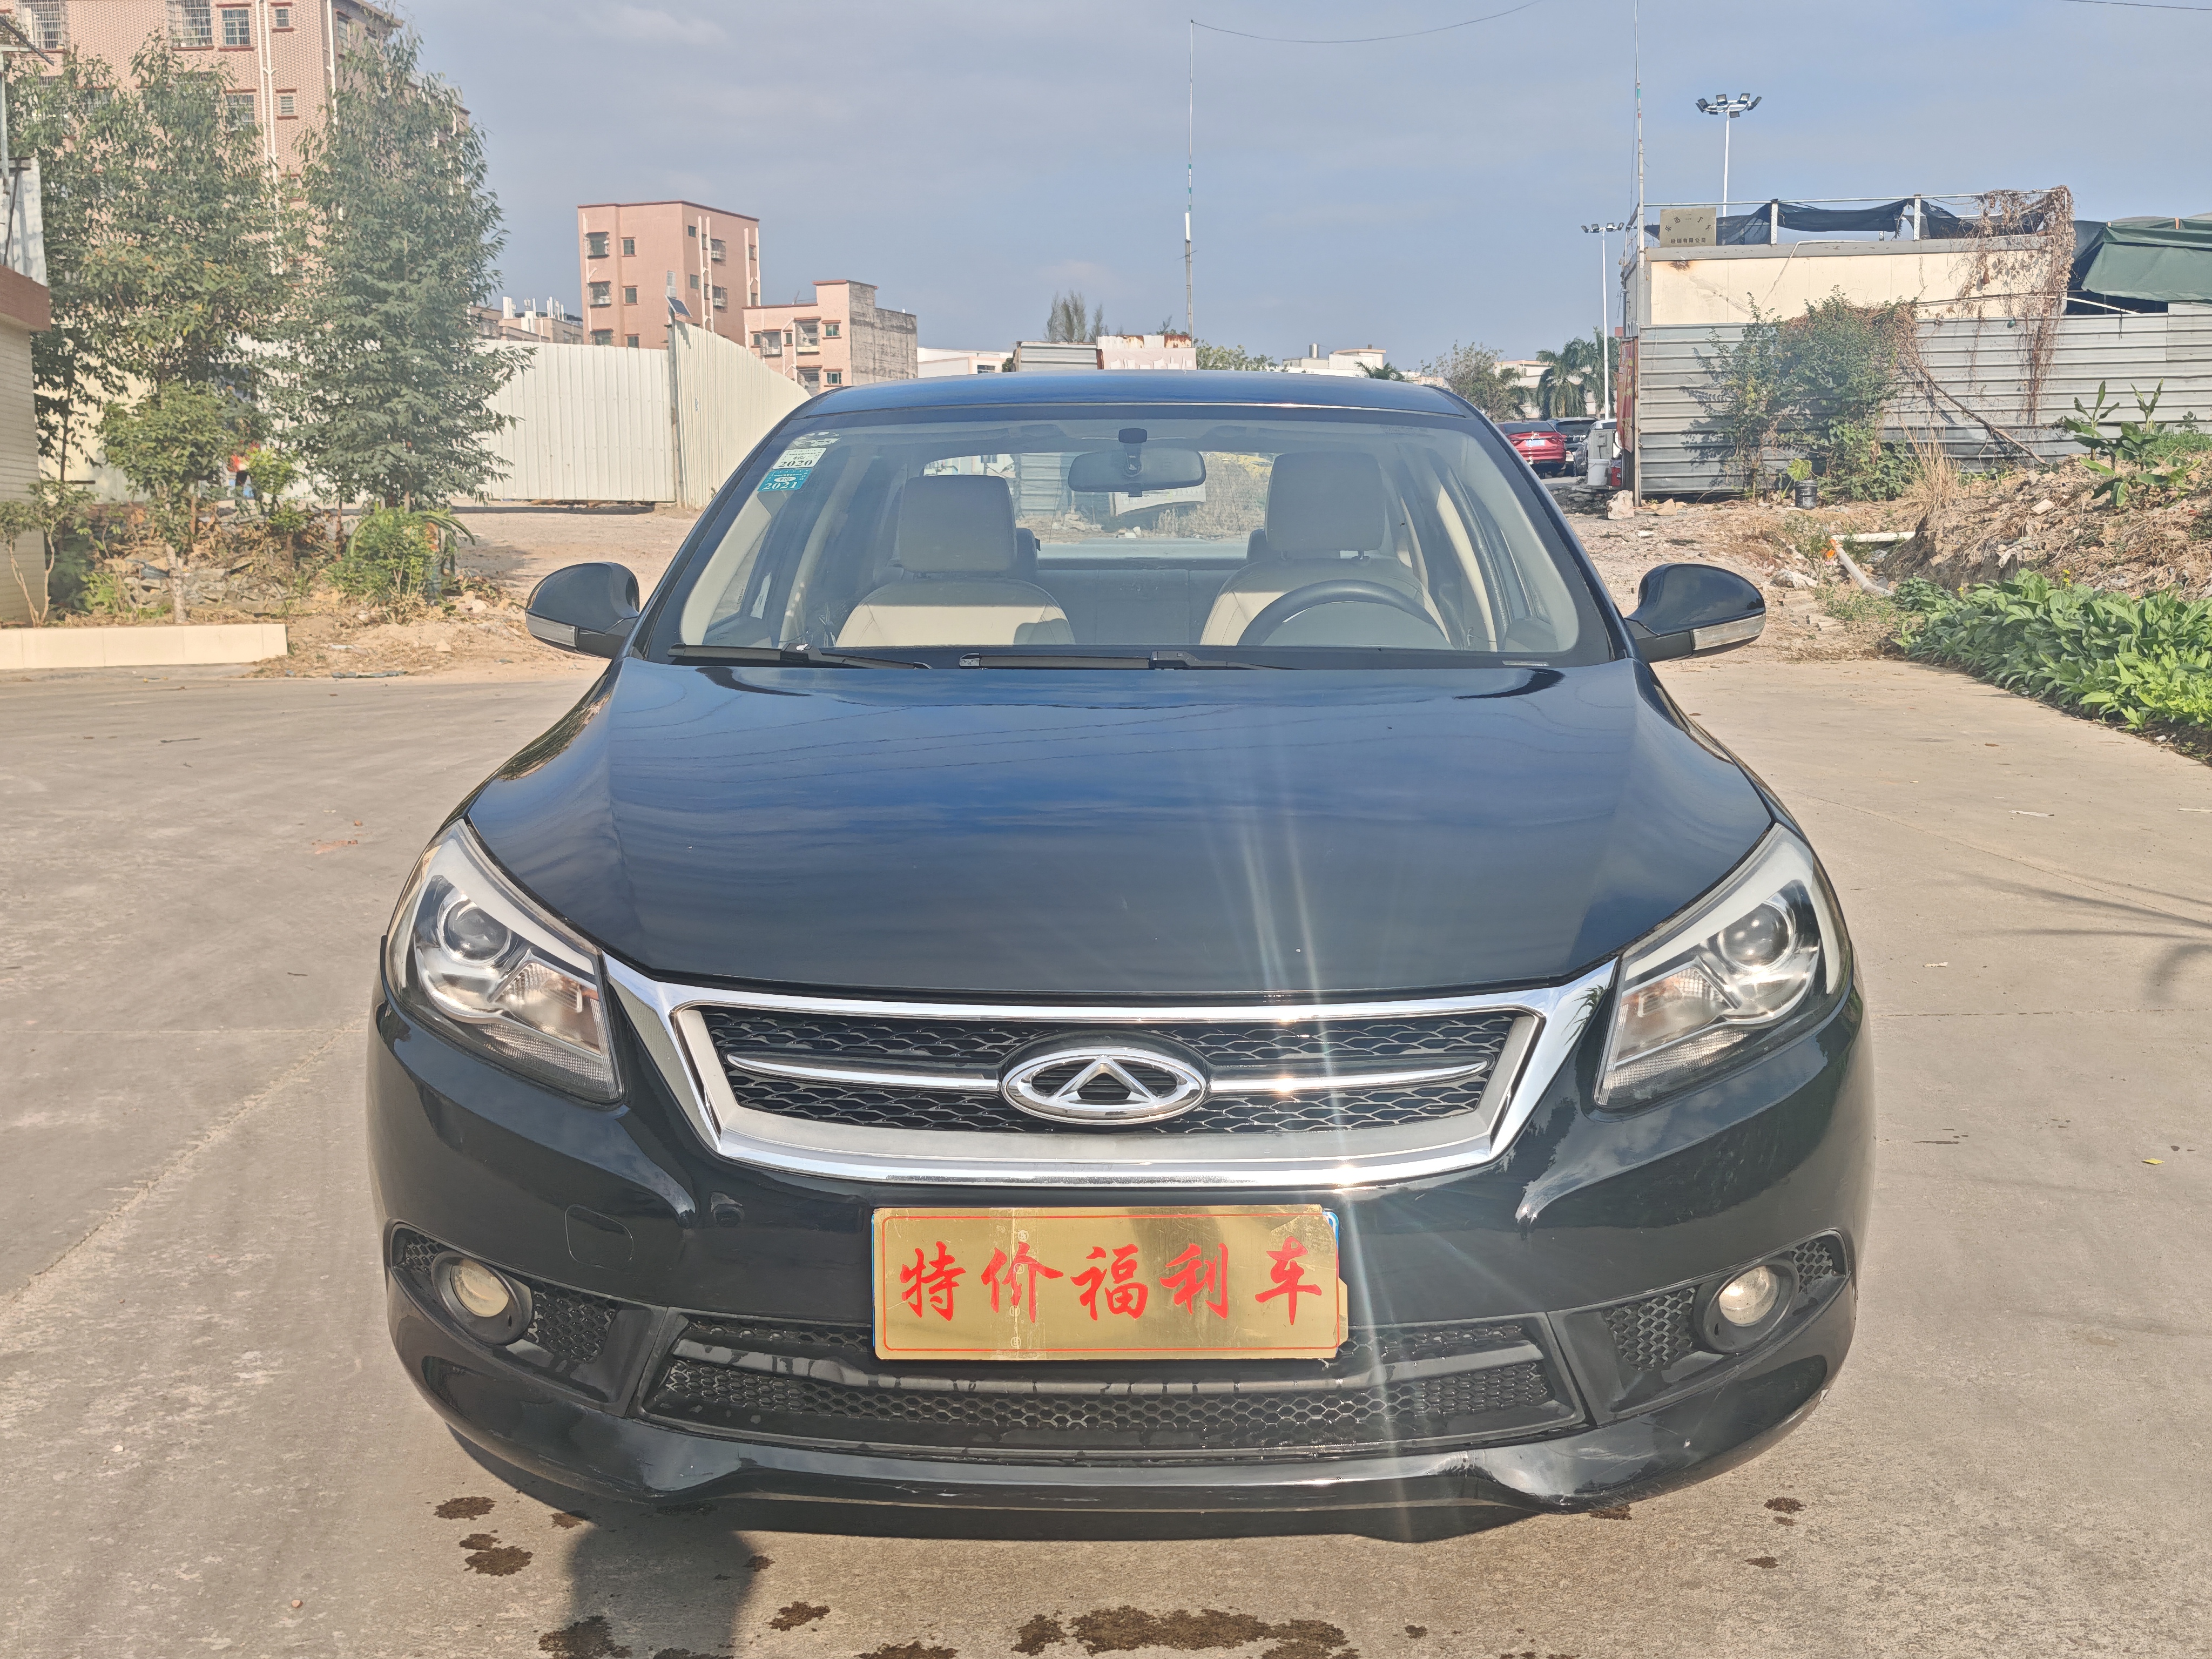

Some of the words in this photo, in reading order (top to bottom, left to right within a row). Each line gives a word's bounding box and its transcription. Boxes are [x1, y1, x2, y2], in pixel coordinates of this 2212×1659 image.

[778, 460, 813, 468] 2020
[761, 481, 798, 490] 2021
[899, 1235, 1323, 1325] 特价福利车
